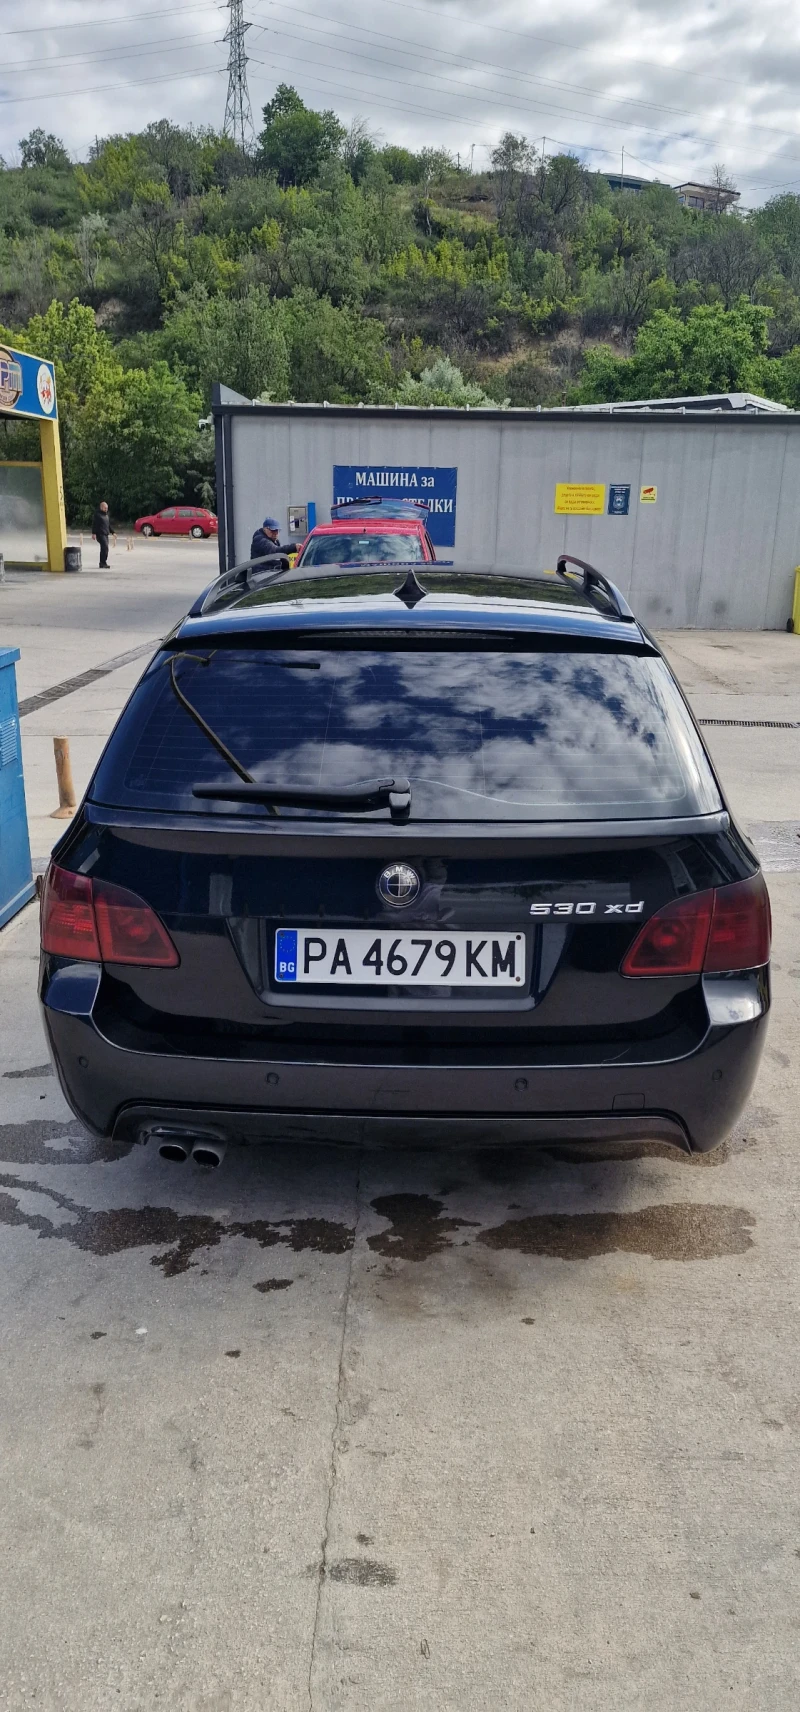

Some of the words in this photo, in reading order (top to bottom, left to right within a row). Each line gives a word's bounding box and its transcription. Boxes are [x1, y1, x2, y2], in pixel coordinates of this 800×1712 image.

[355, 472, 418, 487] МАШИНА
[421, 476, 435, 488] за
[402, 498, 453, 513] ЛКИ
[529, 902, 597, 916] 530
[603, 900, 645, 914] xd
[303, 937, 352, 975] PA
[362, 938, 457, 977] 4679
[465, 940, 516, 978] KM
[279, 961, 295, 973] BG
